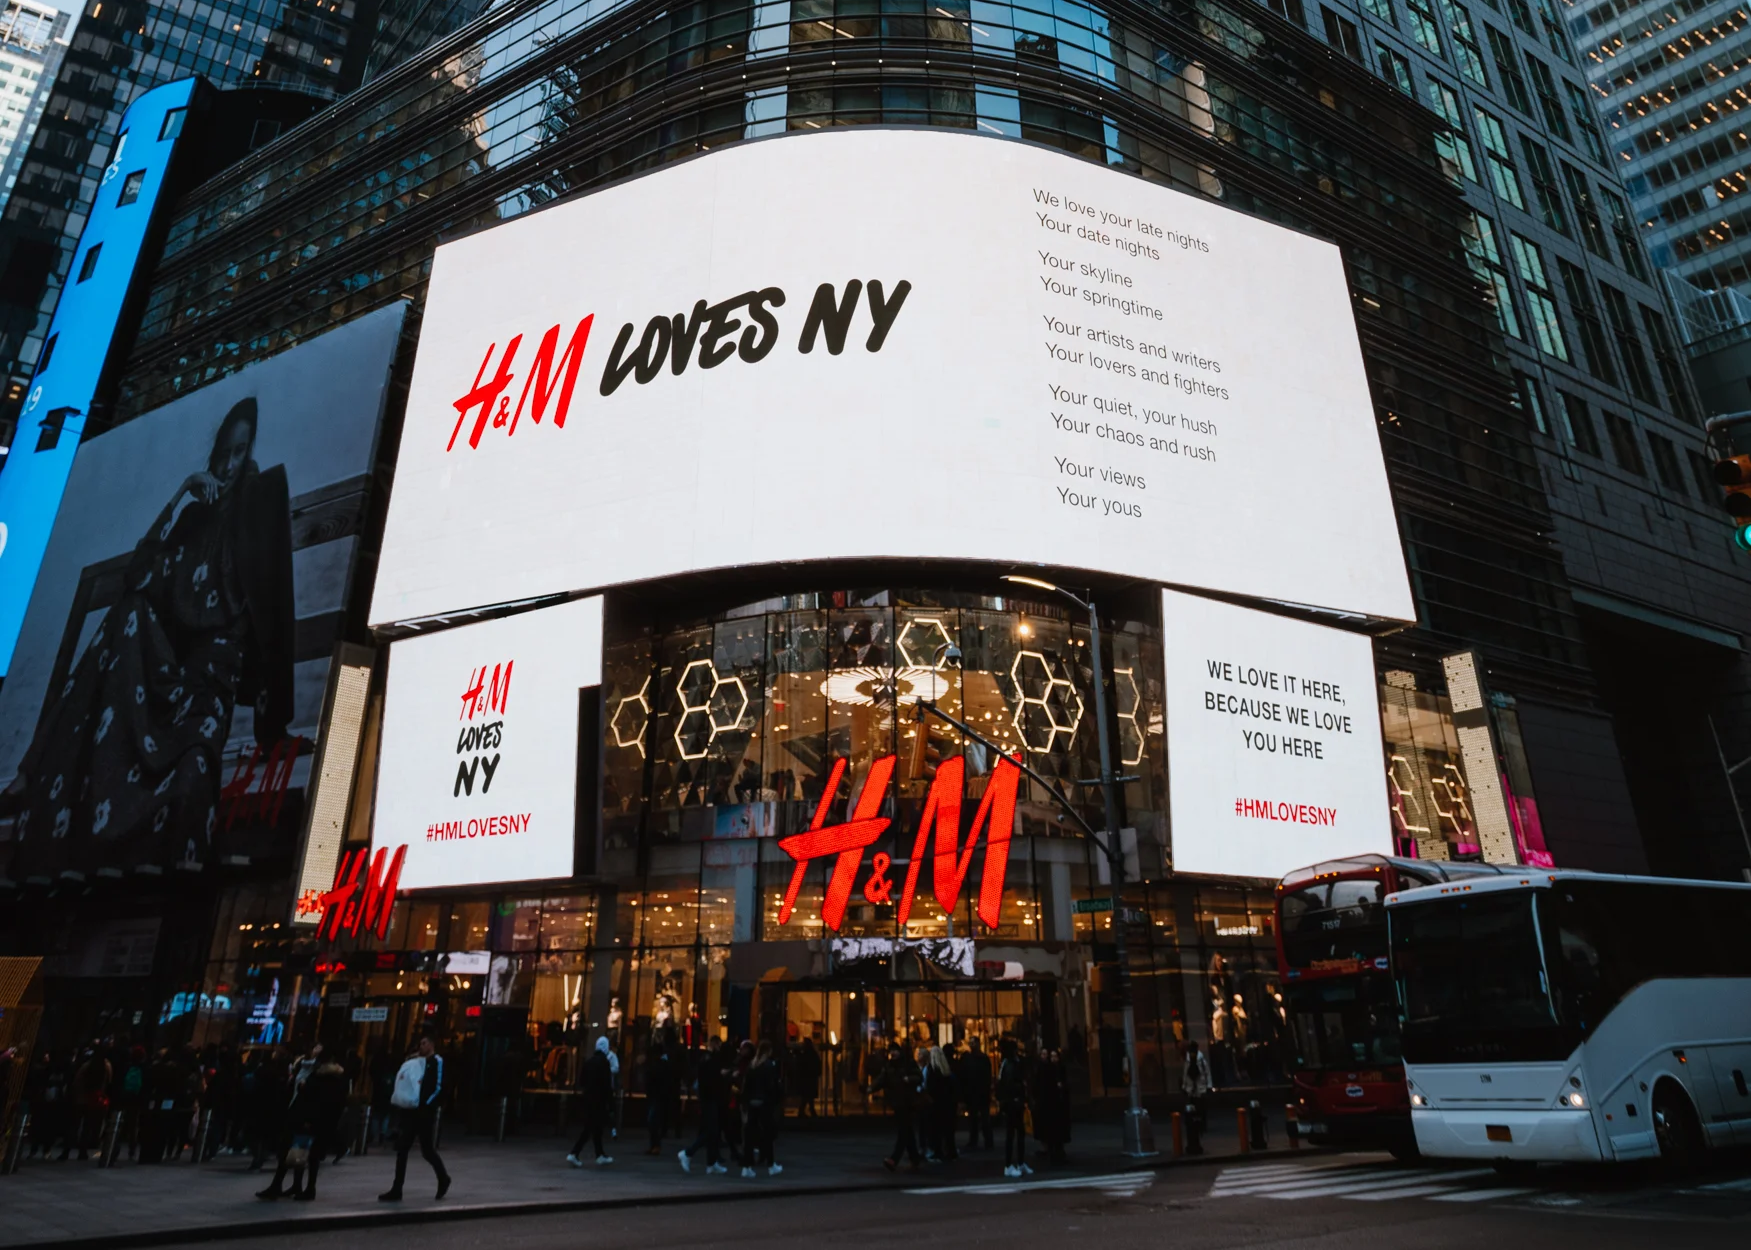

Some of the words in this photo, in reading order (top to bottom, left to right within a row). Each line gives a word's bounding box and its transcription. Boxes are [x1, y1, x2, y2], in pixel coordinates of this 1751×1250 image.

[1032, 188, 1060, 208] We
[1064, 196, 1096, 218] love
[1099, 210, 1133, 229] your
[1136, 218, 1163, 239] late
[1167, 231, 1210, 253] nights
[1035, 211, 1072, 234] Your
[1076, 226, 1111, 246] date
[1115, 238, 1160, 261] nights
[1038, 250, 1076, 272] Your
[1080, 264, 1133, 288] skyline
[1039, 275, 1078, 298] Your
[1082, 290, 1163, 321] springtime
[446, 313, 595, 452] H&M
[600, 286, 786, 396] LOVES
[798, 278, 912, 355] NY
[1043, 315, 1082, 337] Your
[1087, 328, 1135, 351] artists
[1139, 342, 1167, 359] and
[1171, 350, 1222, 374] writers
[1045, 341, 1085, 364] Your
[1089, 351, 1137, 378] lovers
[1141, 368, 1170, 386] and
[1174, 372, 1230, 401] fighters
[1048, 383, 1088, 406] Your
[1093, 396, 1138, 420] quiet,
[1142, 408, 1177, 427] your
[1181, 413, 1218, 436] hush
[1050, 411, 1091, 435] Your
[1095, 422, 1145, 447] chaos
[1149, 438, 1179, 455] and
[1183, 444, 1216, 463] rush
[1054, 455, 1095, 479] Your
[1099, 467, 1146, 490] views
[1056, 486, 1098, 509] Your
[1102, 498, 1142, 518] yous
[460, 660, 514, 721] H&M
[1206, 659, 1233, 682] WE
[1238, 665, 1279, 691] LOVE
[1283, 674, 1297, 694] IT
[1301, 678, 1346, 707] HERE,
[1204, 690, 1282, 722] BECAUSE
[1285, 705, 1310, 727] WE
[1314, 710, 1353, 734] LOVE
[457, 721, 504, 754] LOVES
[1242, 729, 1277, 753] YOU
[1282, 736, 1324, 760] HERE
[454, 753, 501, 798] NY
[426, 813, 531, 842] #HMLOVESNY
[1235, 797, 1337, 827] #HMLOVESNY
[777, 753, 1023, 931] H&M
[316, 844, 408, 942] H&M
